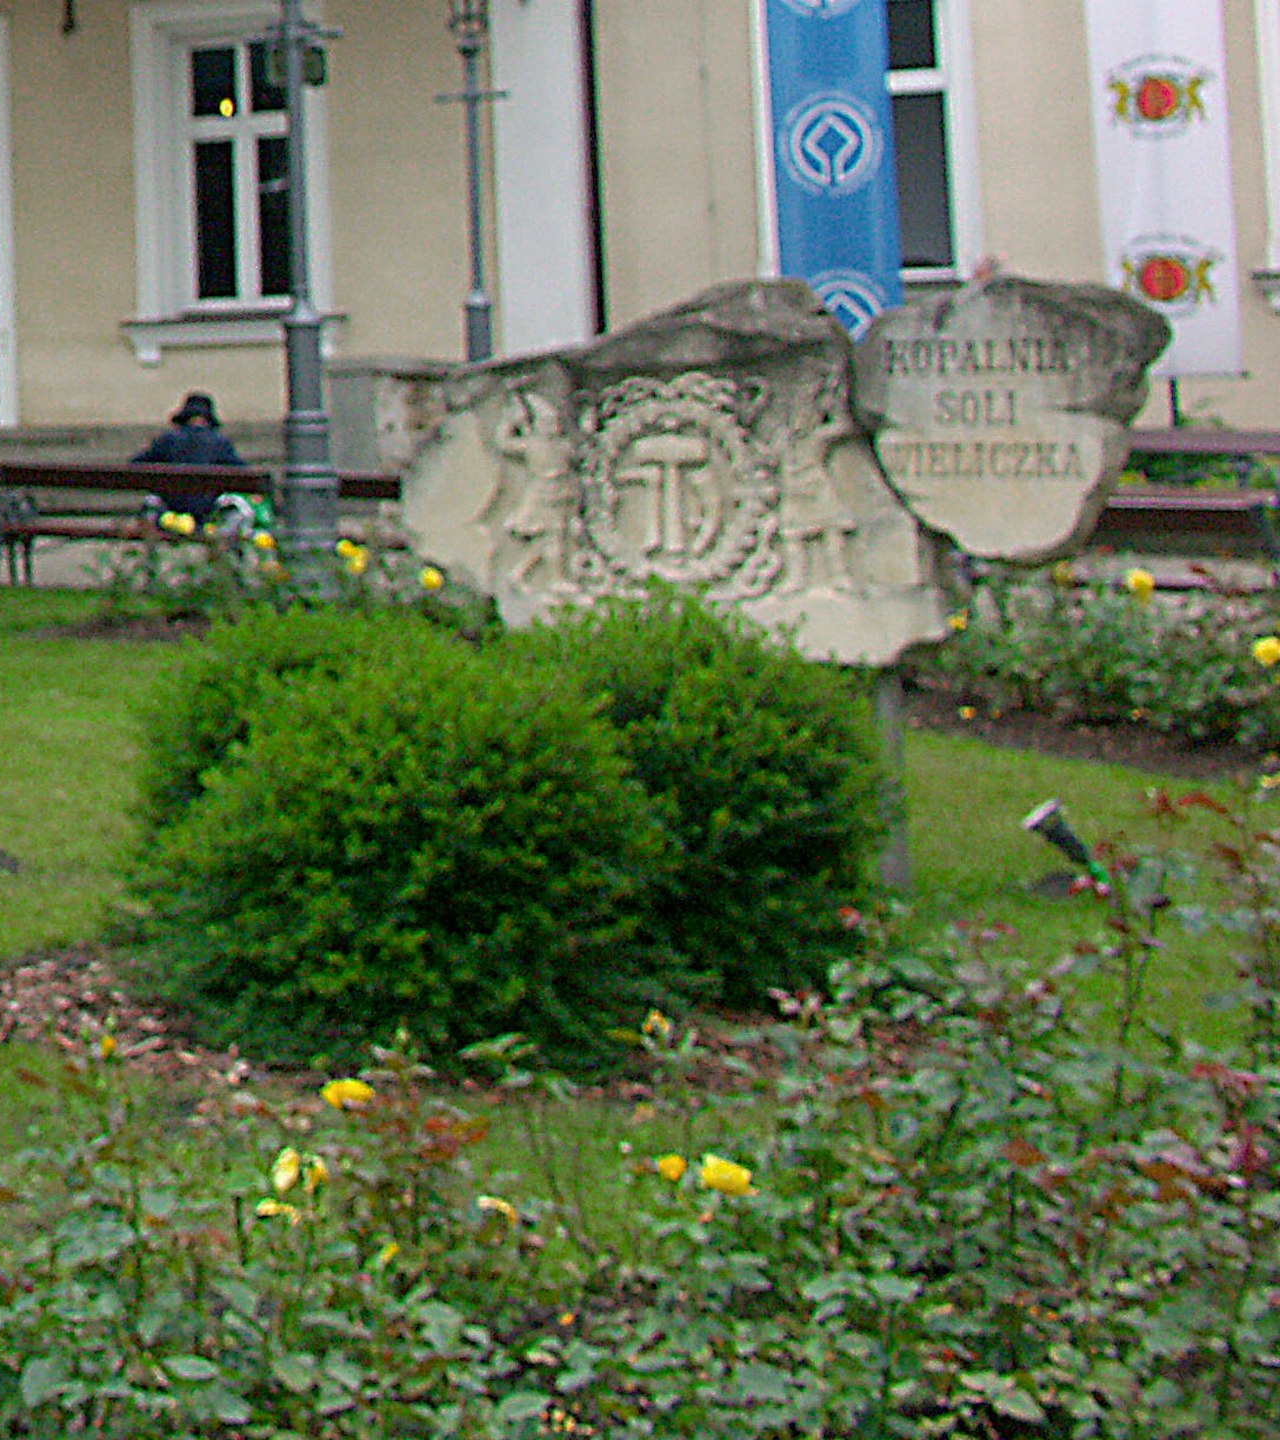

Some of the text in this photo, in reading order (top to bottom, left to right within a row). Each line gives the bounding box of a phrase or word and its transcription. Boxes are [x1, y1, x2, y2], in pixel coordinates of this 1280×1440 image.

[883, 338, 1072, 376] KOPALNIA
[934, 389, 1021, 427] SOLI
[881, 441, 1084, 479] WIELICZKA
